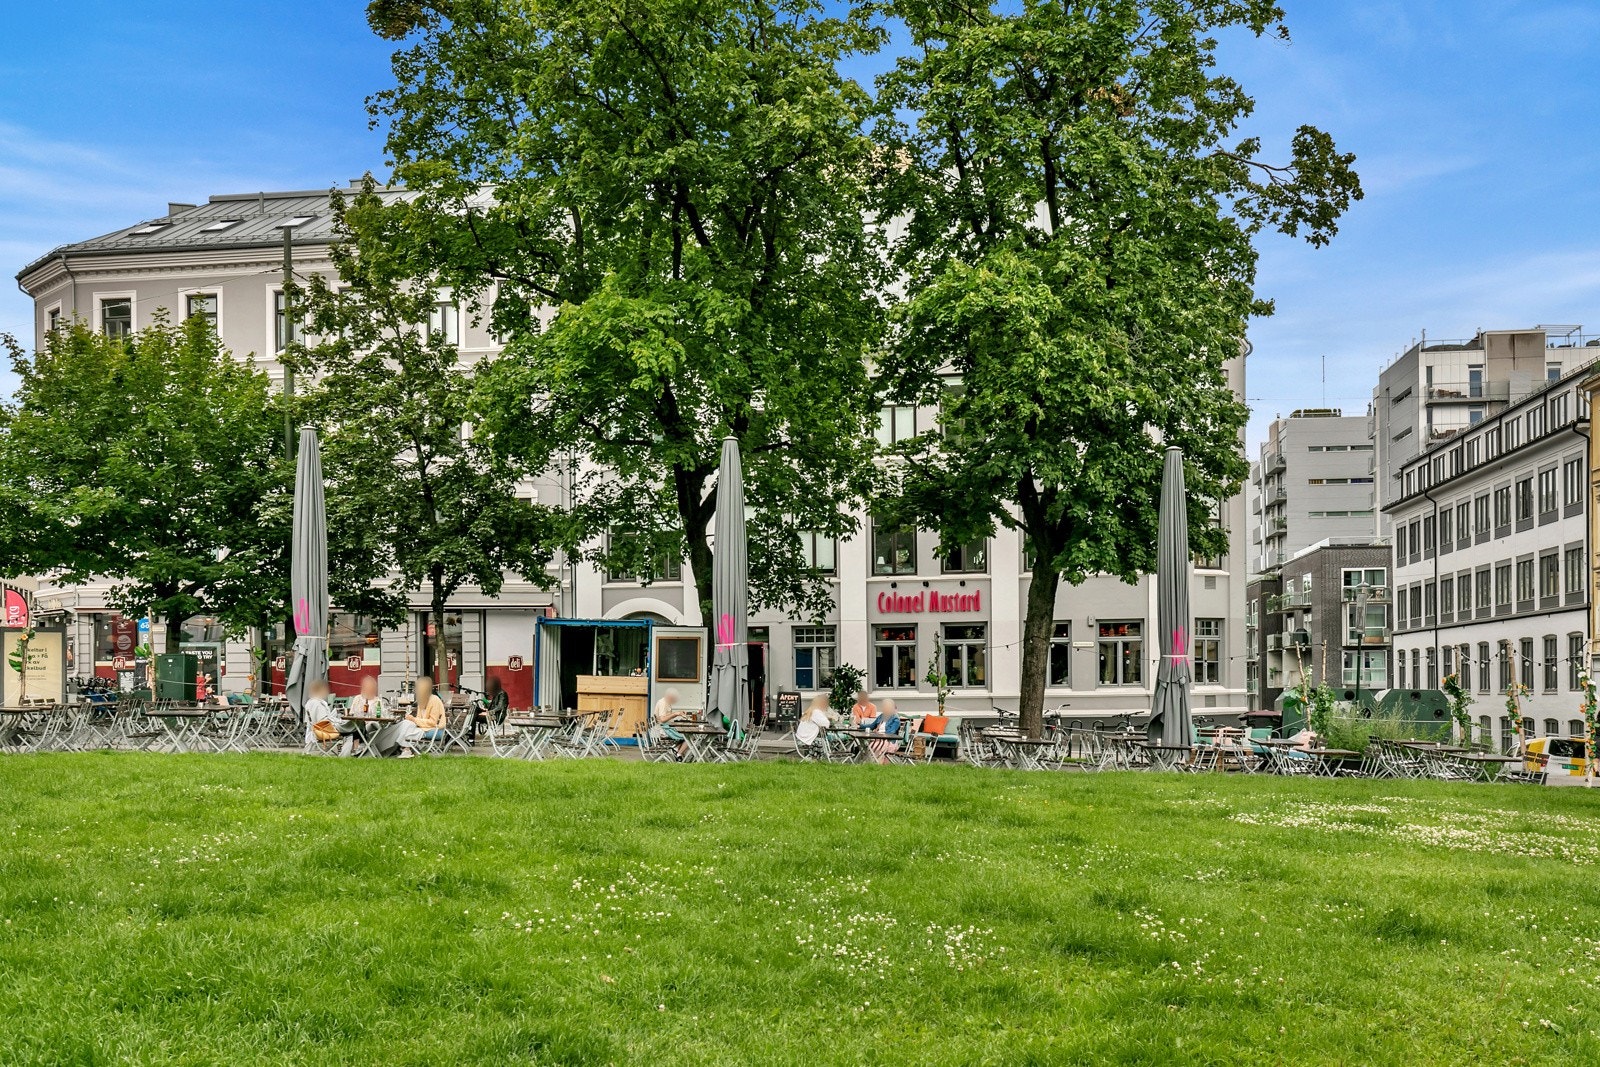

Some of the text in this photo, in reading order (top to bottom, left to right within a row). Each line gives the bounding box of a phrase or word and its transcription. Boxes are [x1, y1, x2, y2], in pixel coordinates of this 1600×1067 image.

[878, 590, 980, 613] Colonel Mustard
[510, 657, 521, 668] deli
